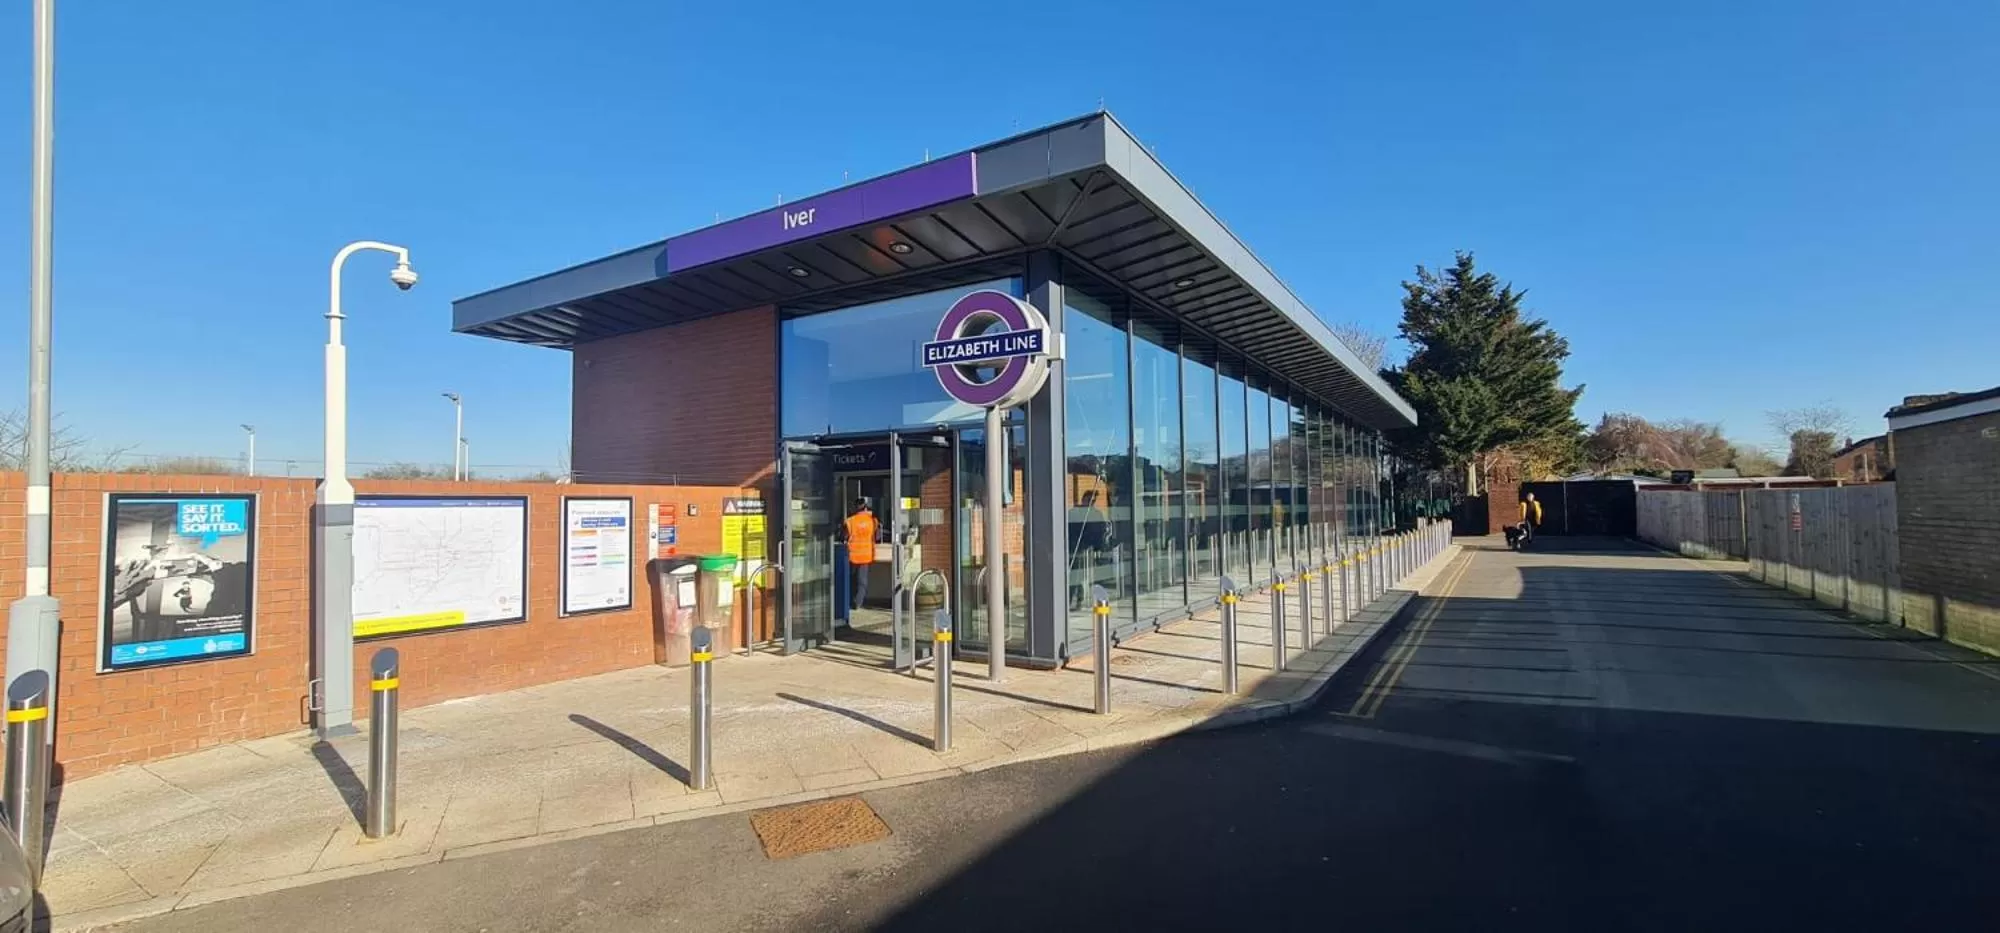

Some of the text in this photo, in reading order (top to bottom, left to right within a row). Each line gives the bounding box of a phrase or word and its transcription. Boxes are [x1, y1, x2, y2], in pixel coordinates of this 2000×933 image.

[784, 208, 815, 230] Iver
[928, 335, 1038, 361] ELIZABETH LINE
[832, 453, 866, 464] Tickets
[182, 504, 208, 513] SEE
[182, 513, 207, 523] SAY
